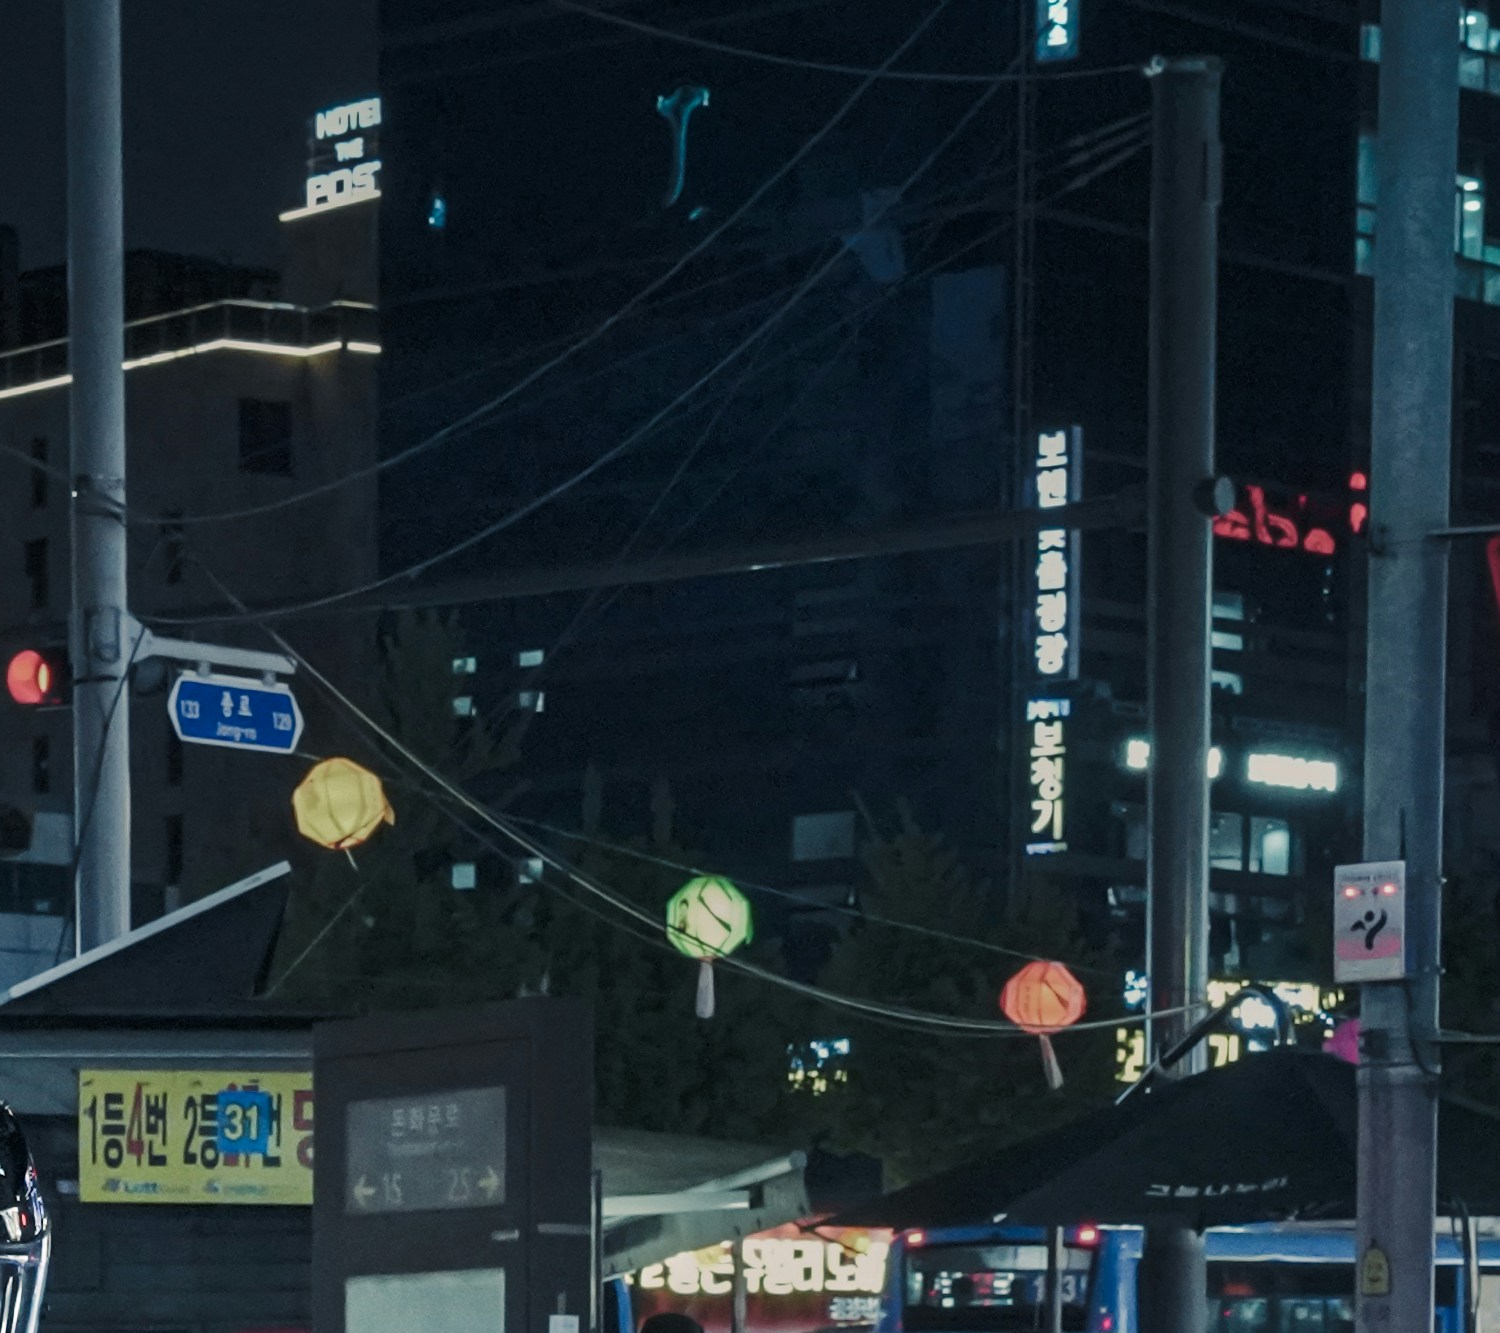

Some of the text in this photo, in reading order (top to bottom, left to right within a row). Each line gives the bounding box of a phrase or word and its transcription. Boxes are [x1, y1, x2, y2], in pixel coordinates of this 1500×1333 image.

[307, 161, 382, 210] POS
[220, 690, 253, 718] 종로
[1029, 721, 1067, 841] 보청기
[86, 1081, 168, 1169] 1등4번
